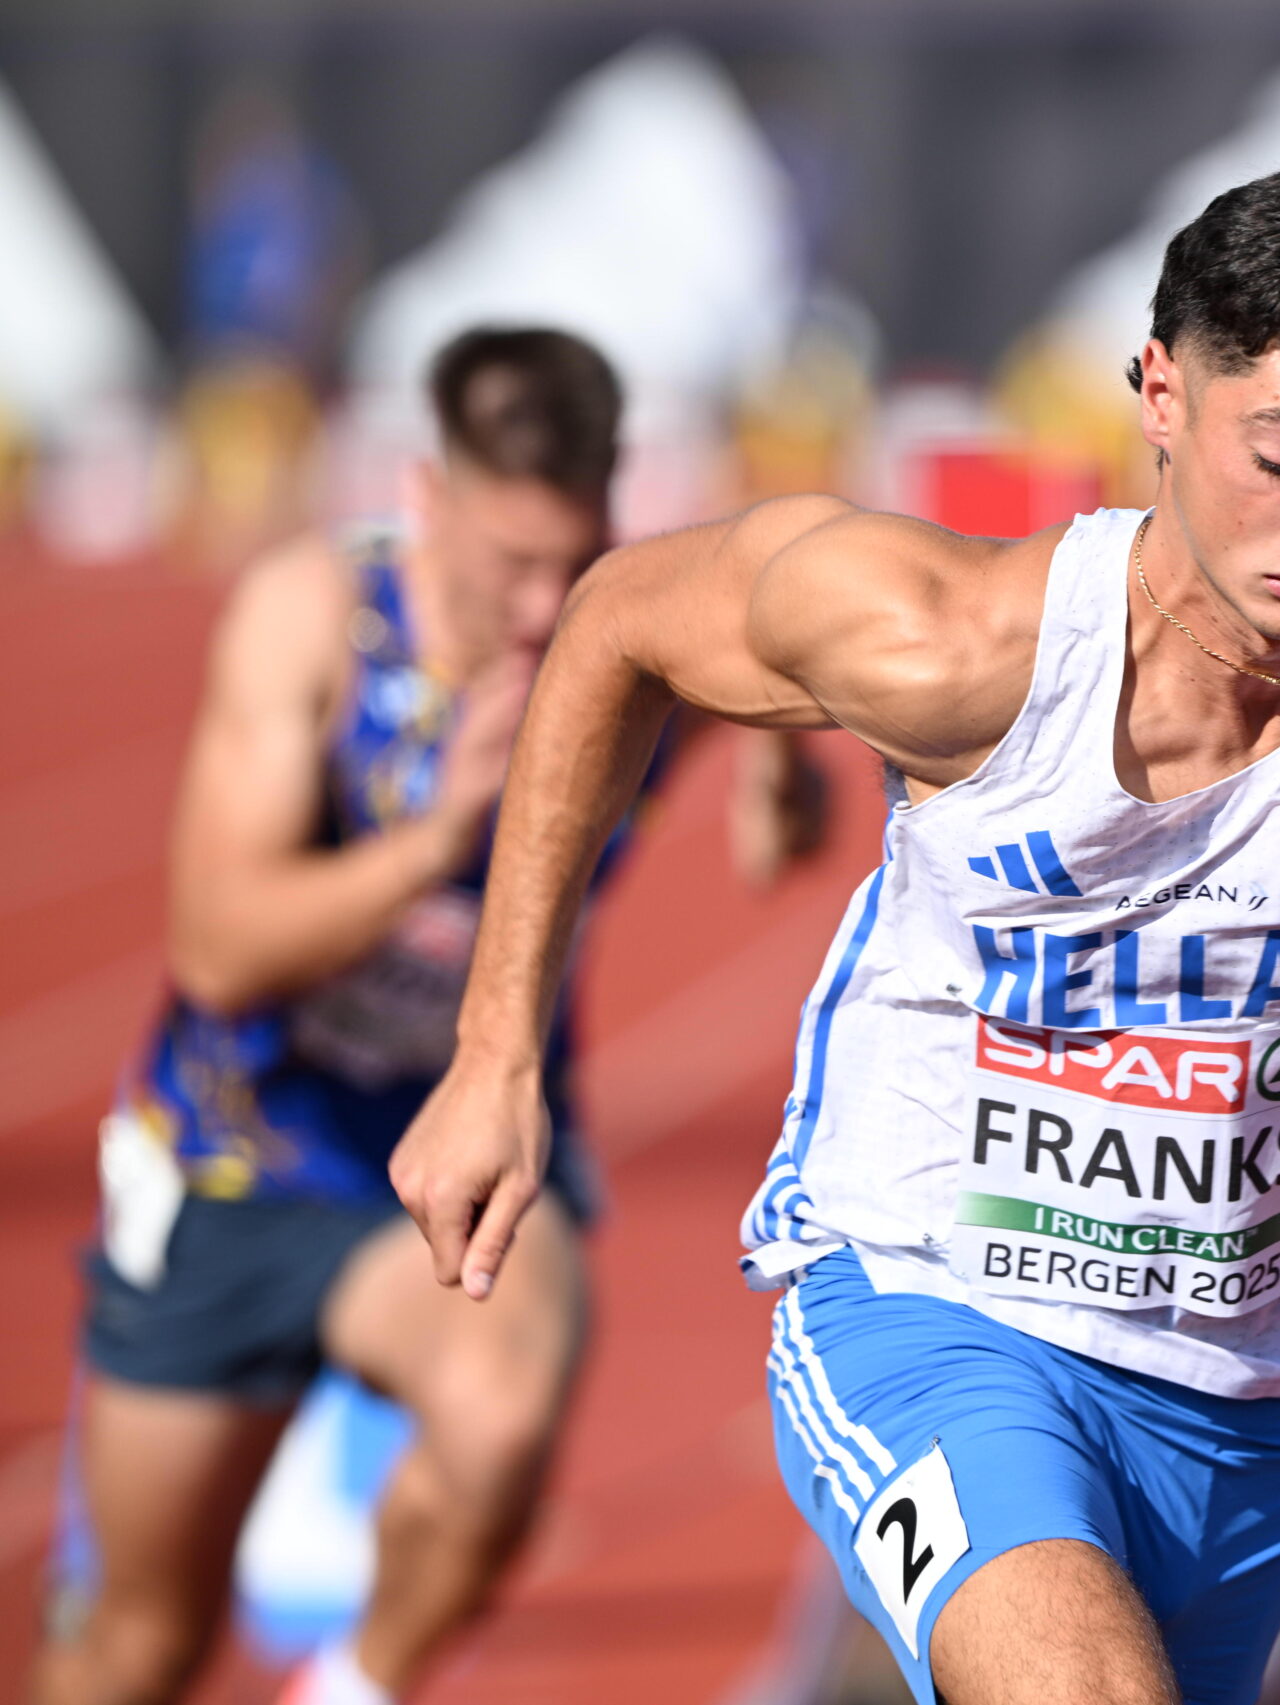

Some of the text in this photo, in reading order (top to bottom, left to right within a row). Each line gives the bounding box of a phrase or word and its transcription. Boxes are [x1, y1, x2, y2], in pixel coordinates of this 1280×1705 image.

[1115, 883, 1238, 911] AEGEAN
[984, 1025, 1243, 1103] SPAR
[1034, 1207, 1044, 1231] I
[1052, 1210, 1125, 1248] RUN
[984, 1242, 1176, 1297] BERGEN
[876, 1497, 934, 1606] 2
